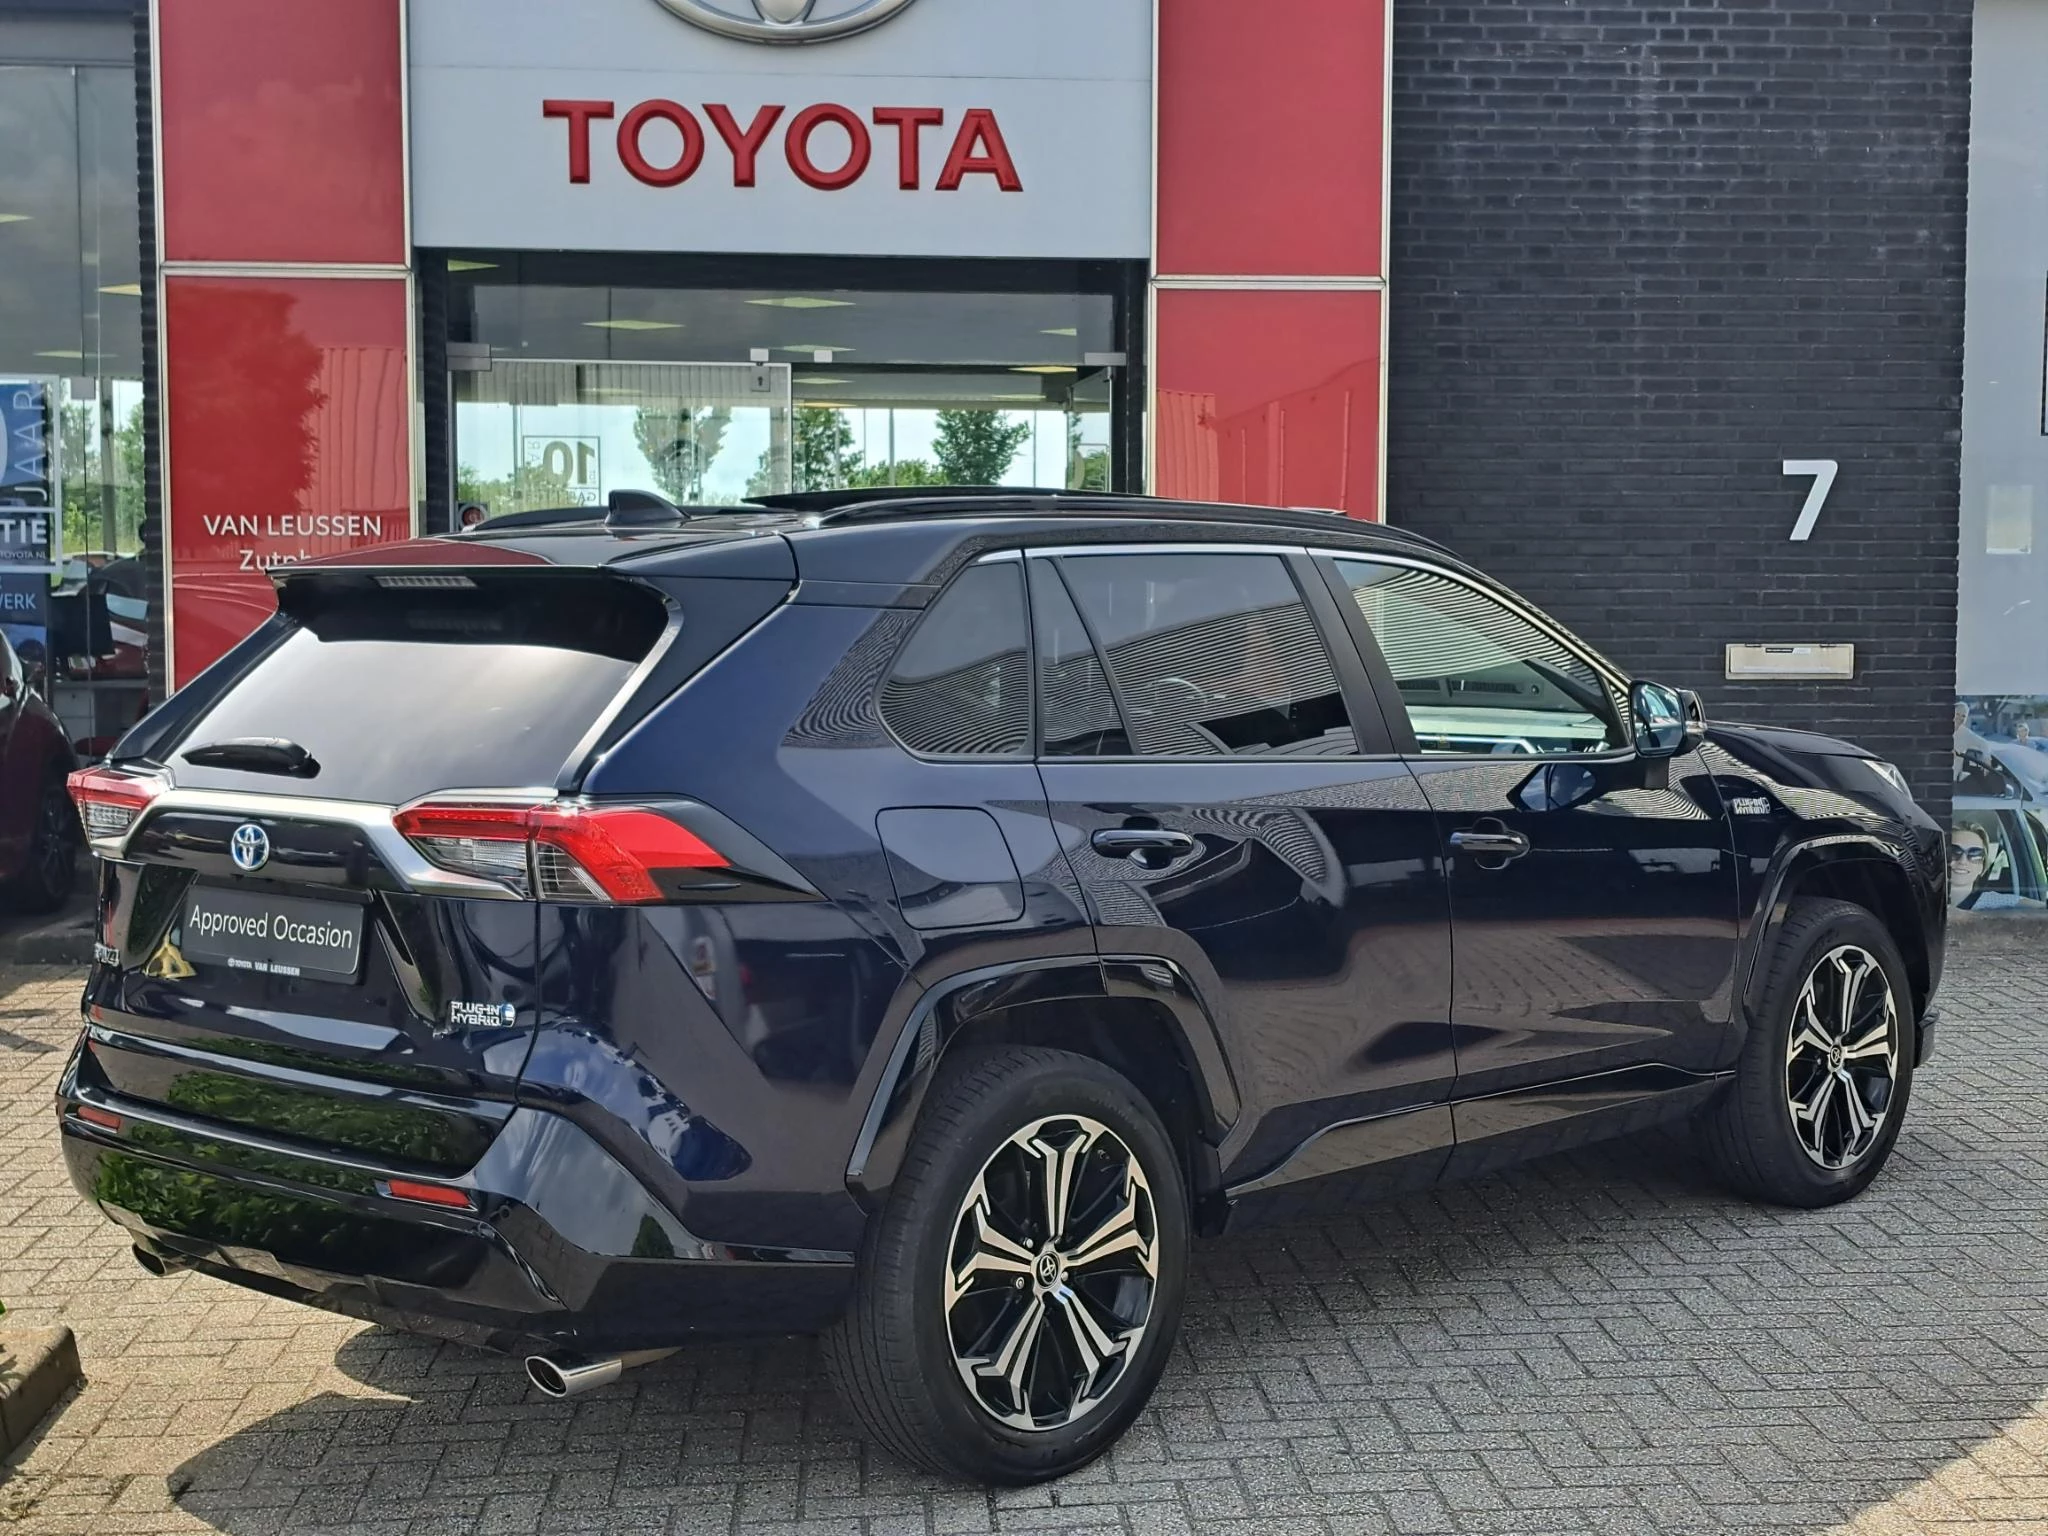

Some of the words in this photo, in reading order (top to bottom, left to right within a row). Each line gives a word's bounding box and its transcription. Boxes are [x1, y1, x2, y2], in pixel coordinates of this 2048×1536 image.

[543, 98, 1023, 192] TOYOTA
[13, 389, 47, 502] JAAR
[1783, 460, 1838, 540] 7
[203, 514, 258, 536] VAN
[267, 514, 381, 536] LEUSSEN
[189, 904, 268, 937] Approved
[273, 914, 353, 949] Occasion
[254, 961, 268, 972] VAN
[270, 964, 300, 976] LEUSSEN
[450, 1001, 501, 1016] PLUG-IN
[450, 1012, 502, 1027] HYBRID
